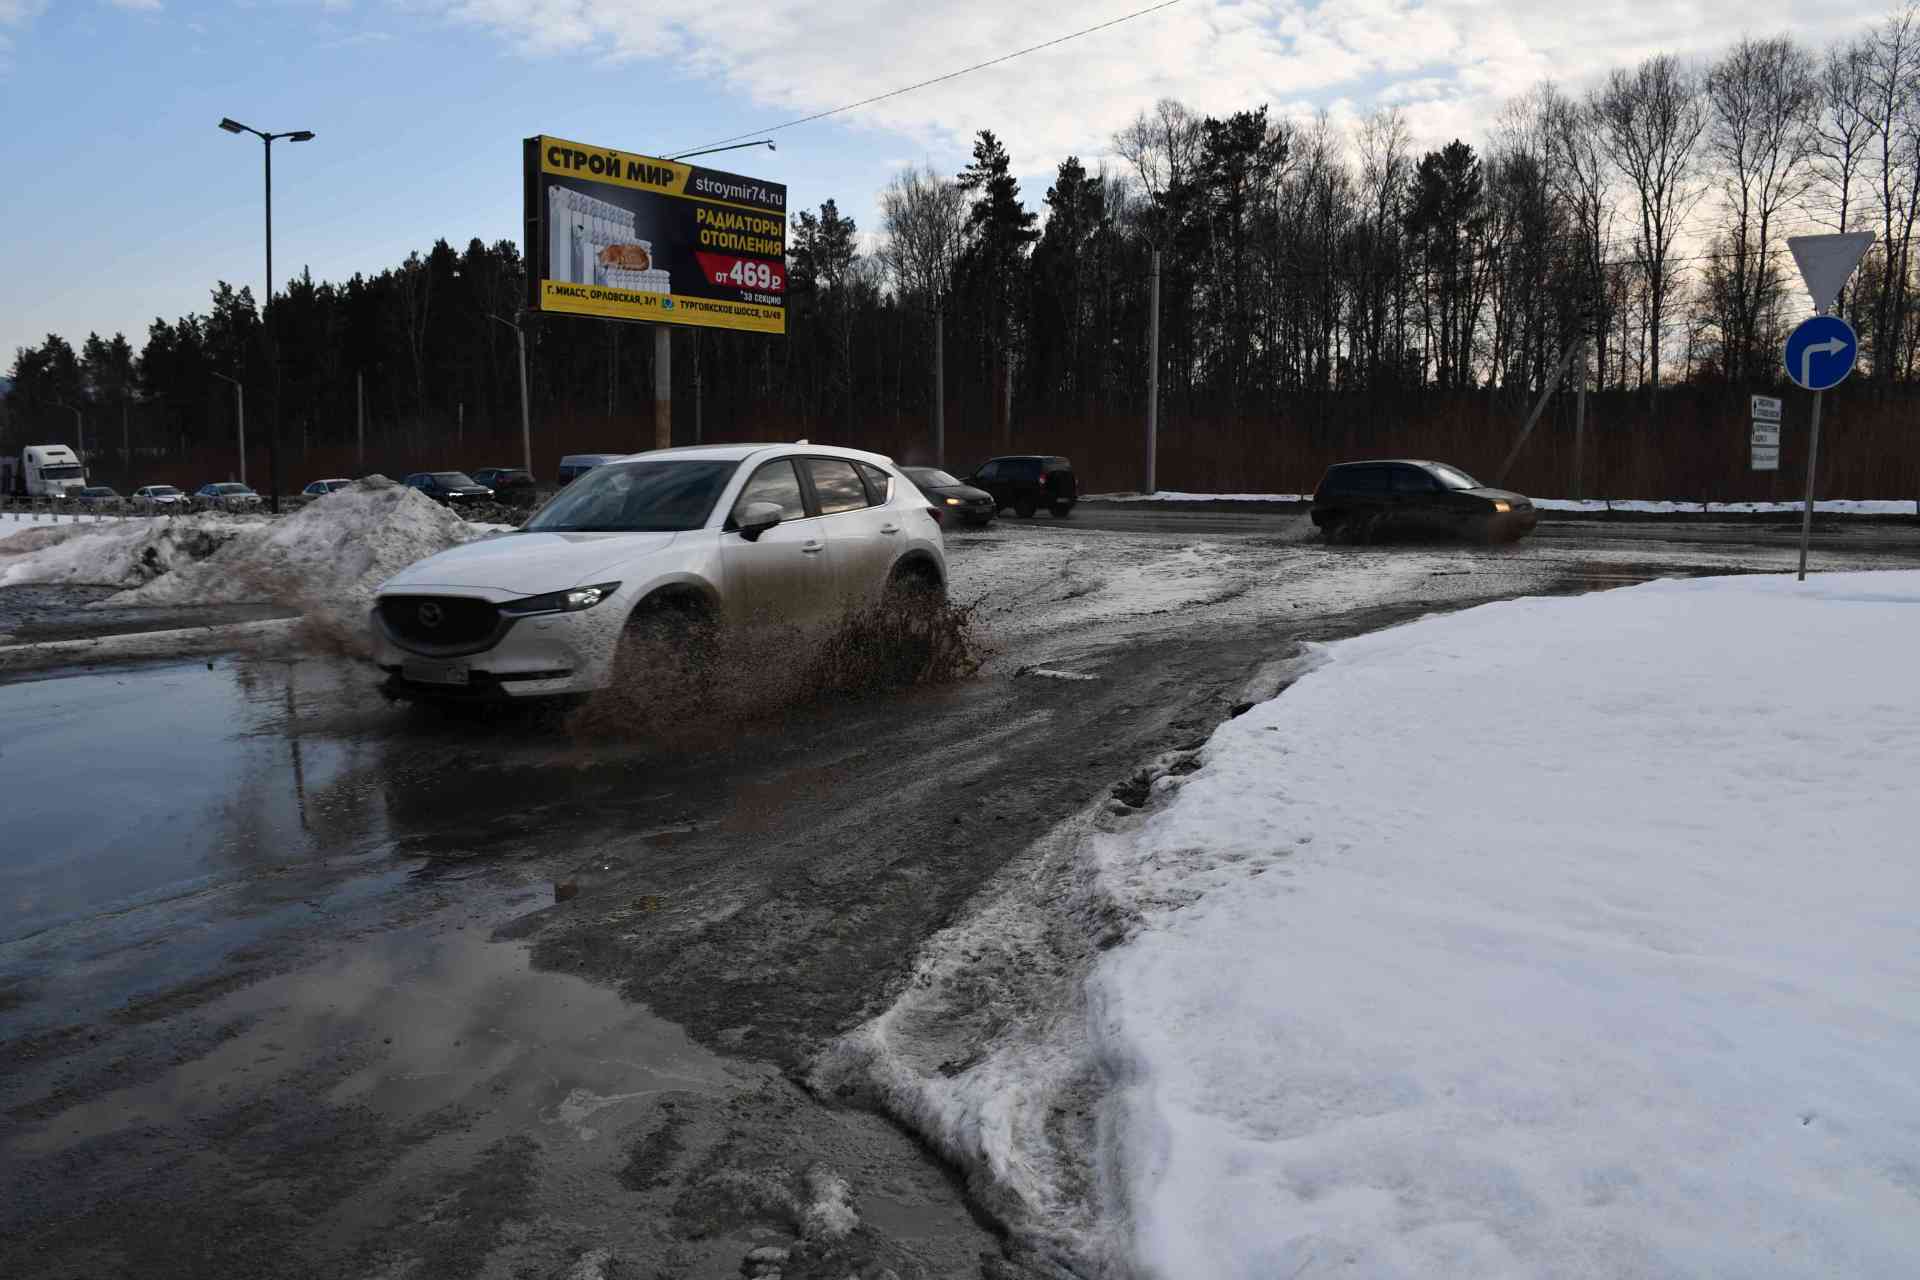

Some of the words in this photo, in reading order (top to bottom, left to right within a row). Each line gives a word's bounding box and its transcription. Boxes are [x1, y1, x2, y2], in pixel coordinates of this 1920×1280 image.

[547, 146, 621, 178] СТРОЙ
[627, 161, 674, 187] МИР
[695, 177, 783, 206] stroymir74.ru
[696, 207, 783, 237] РАДИАТОРЫ
[700, 229, 782, 257] ОТОПЛЕНИЯ
[556, 286, 589, 300] МИАСС,
[590, 289, 642, 306] ОРЛОВСКАЯ,
[680, 300, 733, 314] ТУРГОЯКСКОЕ
